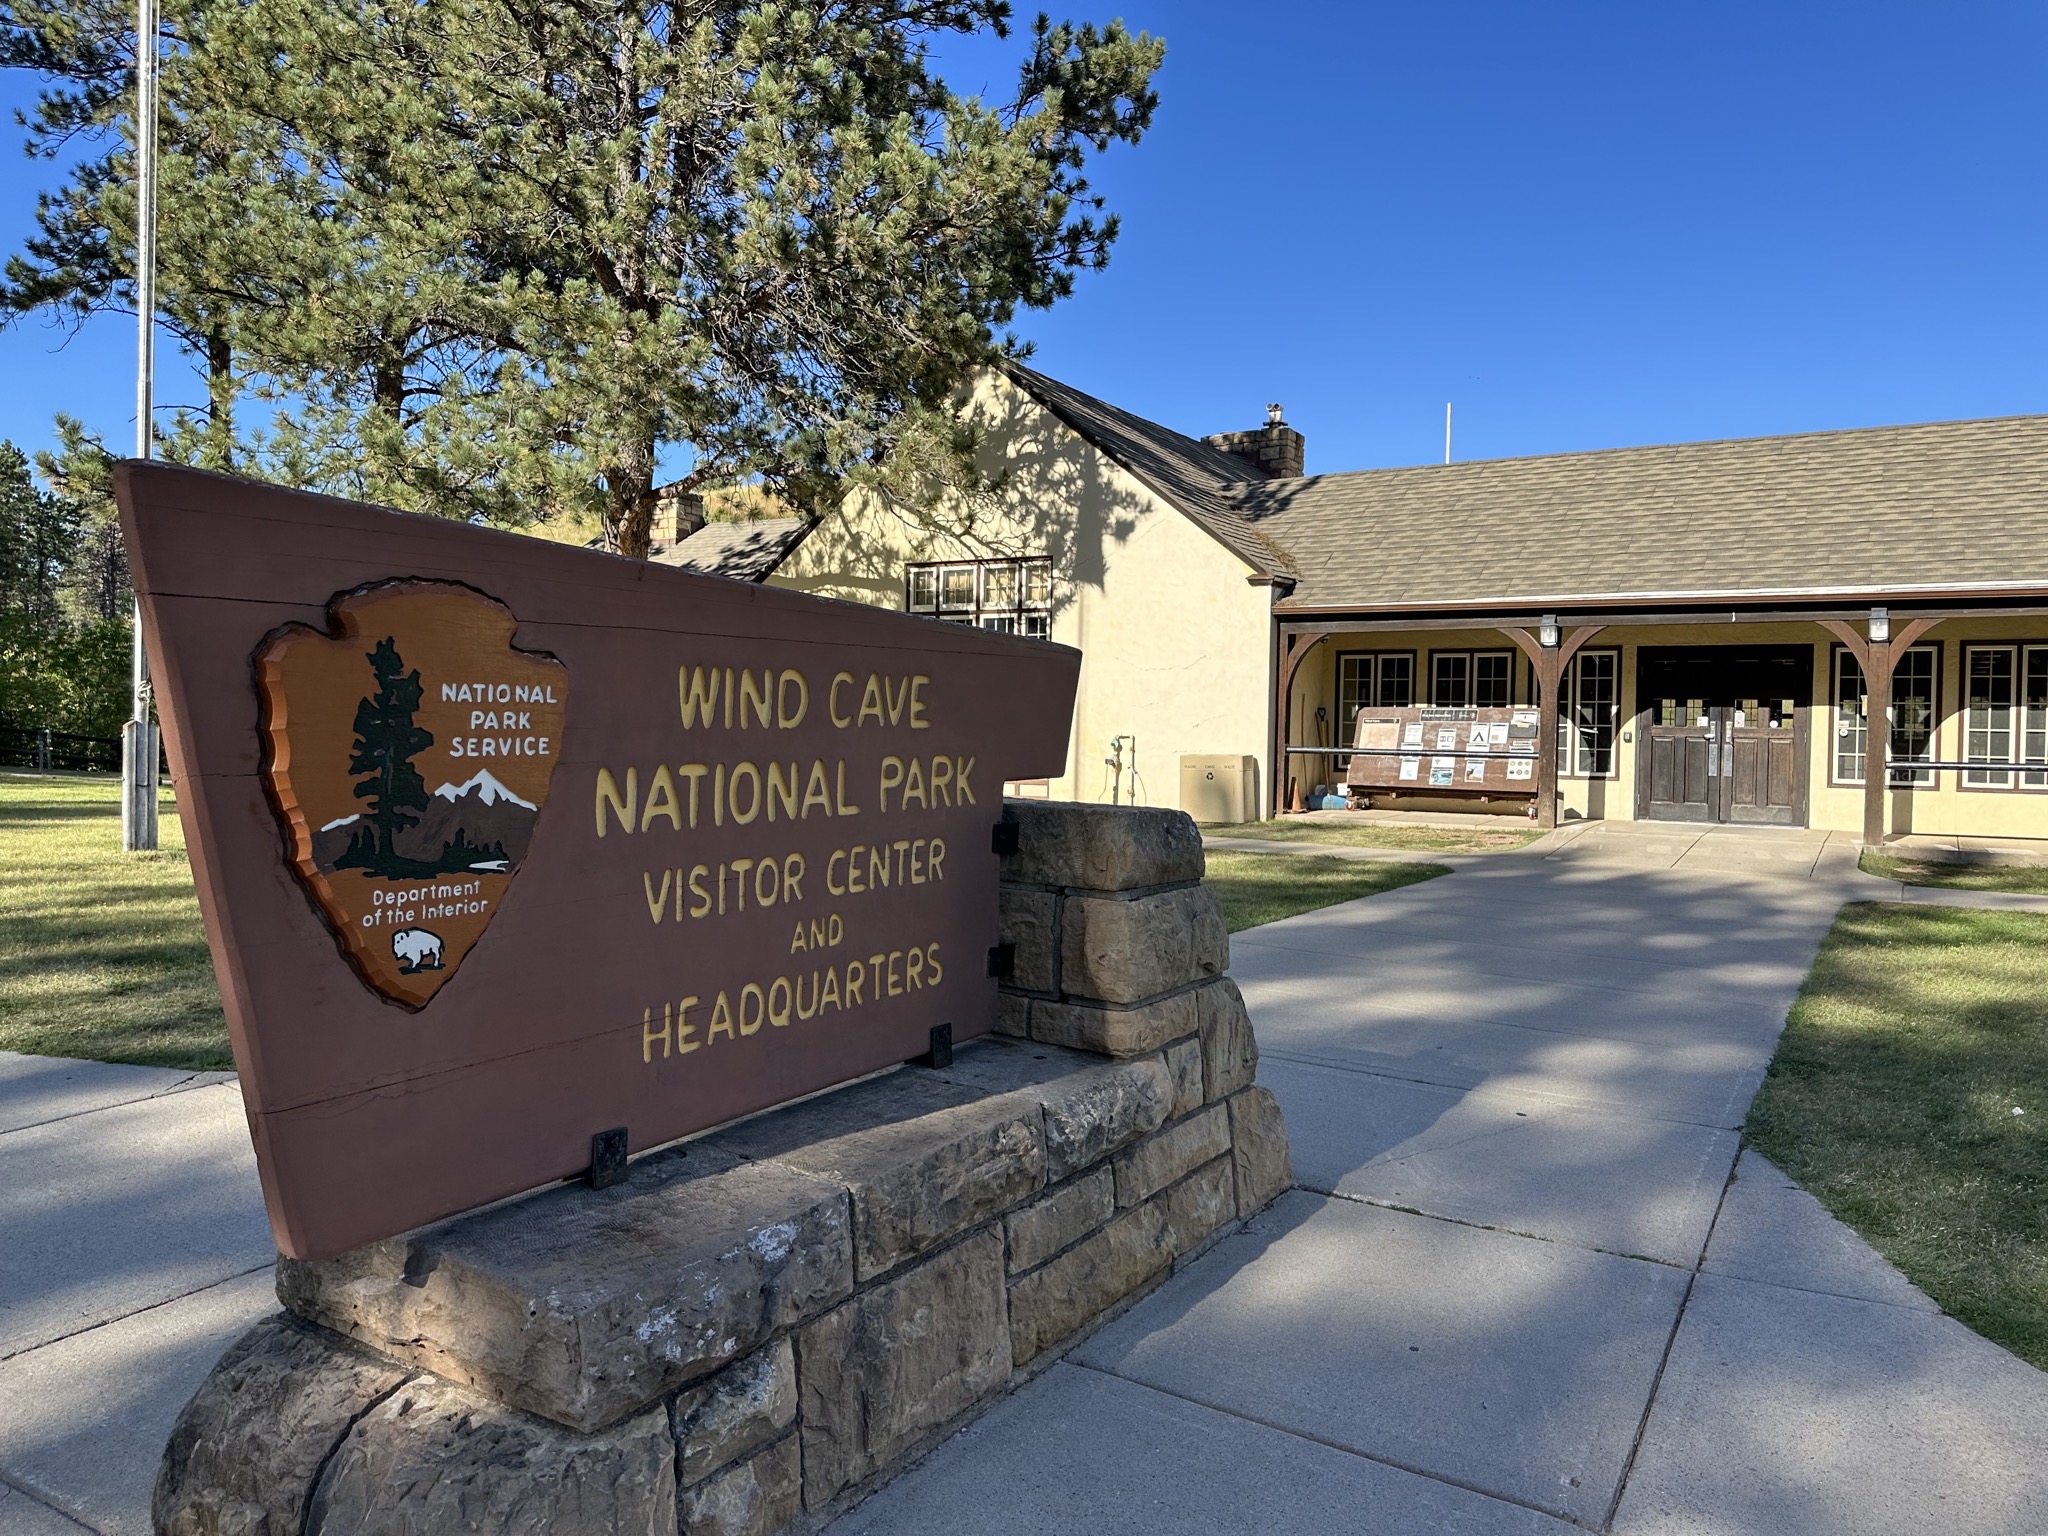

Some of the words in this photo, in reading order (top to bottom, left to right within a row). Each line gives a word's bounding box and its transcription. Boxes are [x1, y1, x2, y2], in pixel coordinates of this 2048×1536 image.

[442, 682, 558, 704] NATIONAL
[679, 664, 809, 729] WIND
[829, 671, 932, 729] CAVE
[471, 710, 531, 730] PARK
[449, 736, 550, 757] SERVICE
[595, 759, 861, 838] NATIONAL
[880, 755, 977, 813] PARK
[373, 880, 480, 907] Department
[643, 852, 806, 925] VISITOR
[827, 837, 946, 896] CENTER
[362, 908, 382, 927] of
[387, 908, 415, 925] the
[422, 899, 488, 919] Interior
[790, 913, 845, 955] AND
[643, 942, 943, 1064] HEADQUARTERS
